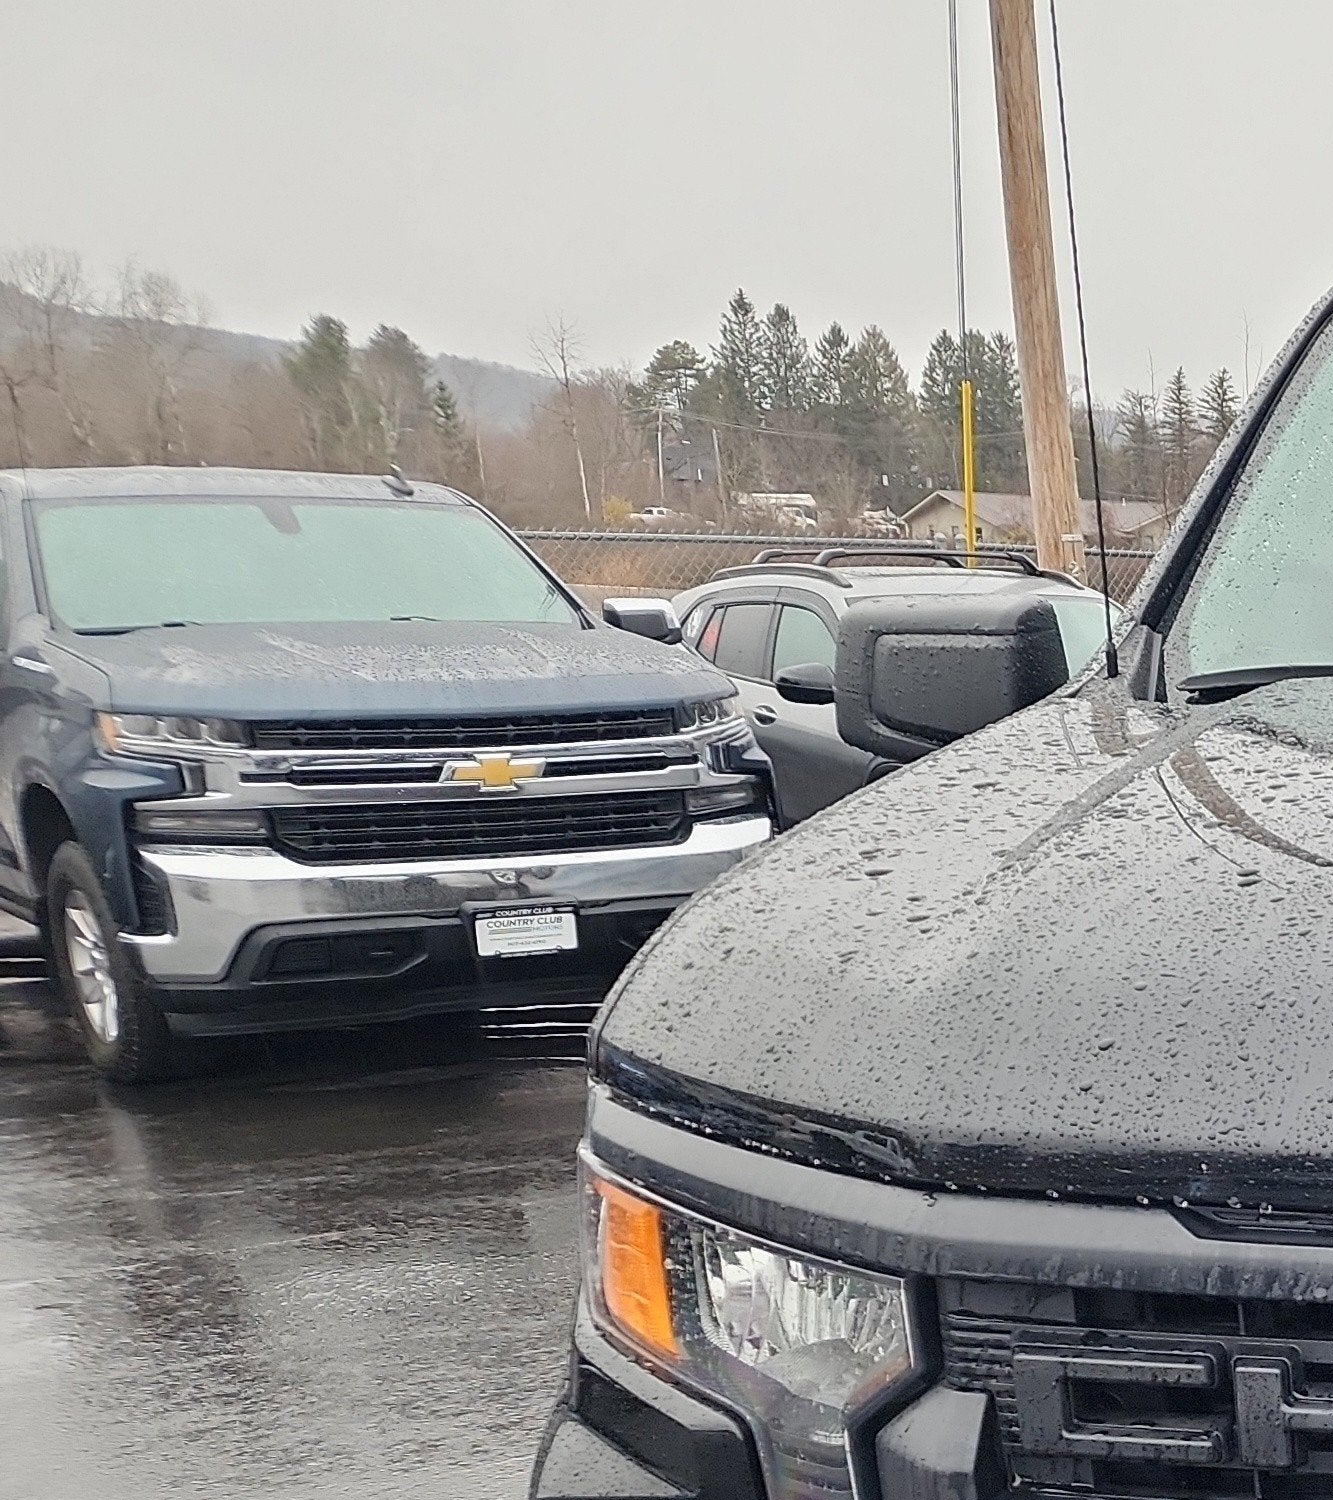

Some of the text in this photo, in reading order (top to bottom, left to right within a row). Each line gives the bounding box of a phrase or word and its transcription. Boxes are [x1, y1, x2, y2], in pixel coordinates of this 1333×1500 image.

[495, 908, 532, 917] COUNTRY
[487, 916, 563, 929] COUNTRY CLUB
